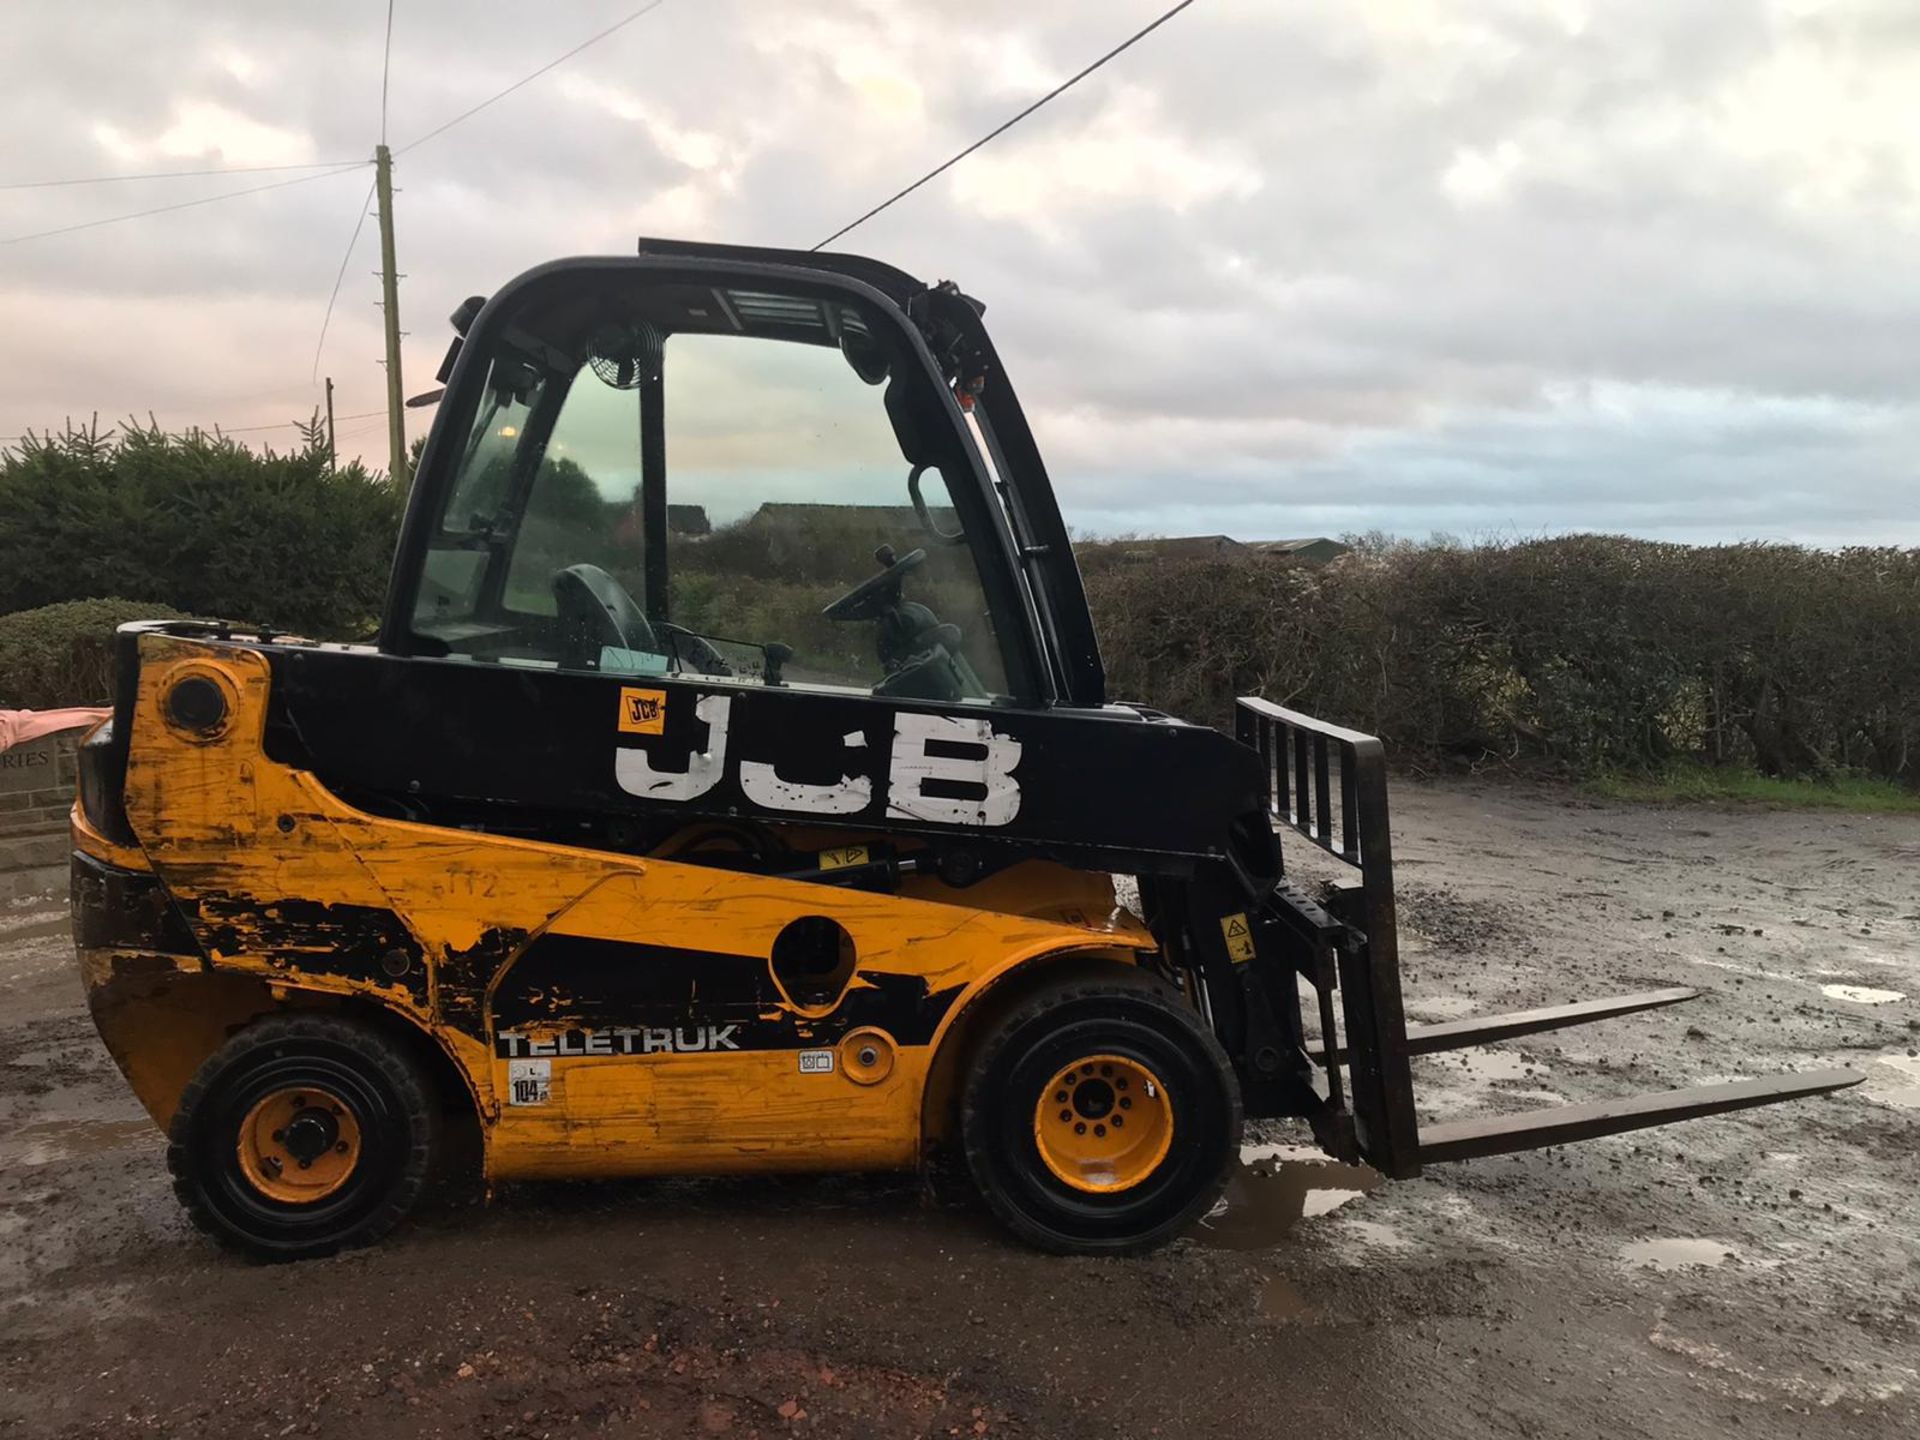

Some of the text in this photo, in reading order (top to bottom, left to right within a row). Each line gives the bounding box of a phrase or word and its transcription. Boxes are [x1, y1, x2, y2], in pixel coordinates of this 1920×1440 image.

[632, 697, 659, 721] JCB
[498, 1025, 740, 1057] TELETRUK
[513, 1079, 538, 1103] 104
